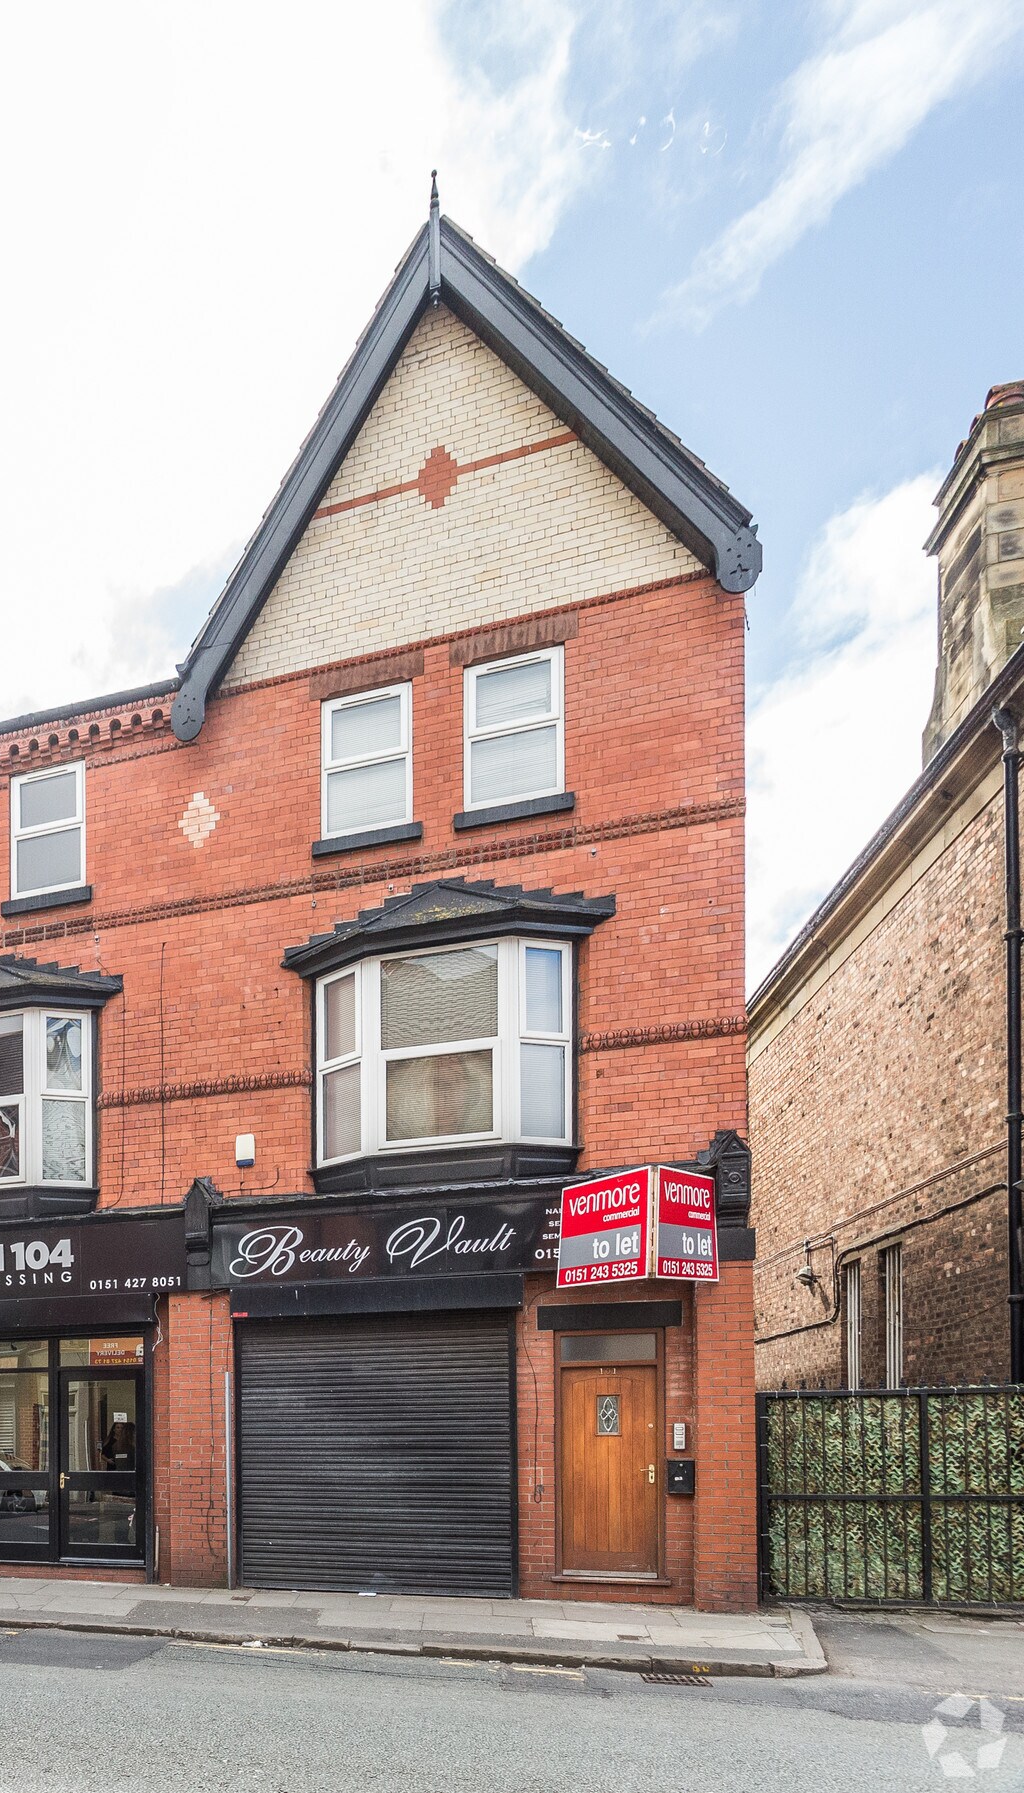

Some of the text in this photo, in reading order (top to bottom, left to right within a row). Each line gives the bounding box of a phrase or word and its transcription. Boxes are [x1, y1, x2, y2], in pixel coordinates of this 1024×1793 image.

[569, 1182, 640, 1217] venmore
[664, 1180, 711, 1208] venmore
[602, 1206, 640, 1223] commercial
[687, 1211, 711, 1221] commercial
[10, 1239, 74, 1272] 104
[229, 1215, 517, 1278] Beauty Vault
[592, 1231, 639, 1259] to let
[681, 1232, 713, 1257] to let
[565, 1261, 638, 1283] 0151 243 5325
[662, 1260, 713, 1277] 0151 243 5325
[89, 1276, 182, 1290] 0151 427 8051
